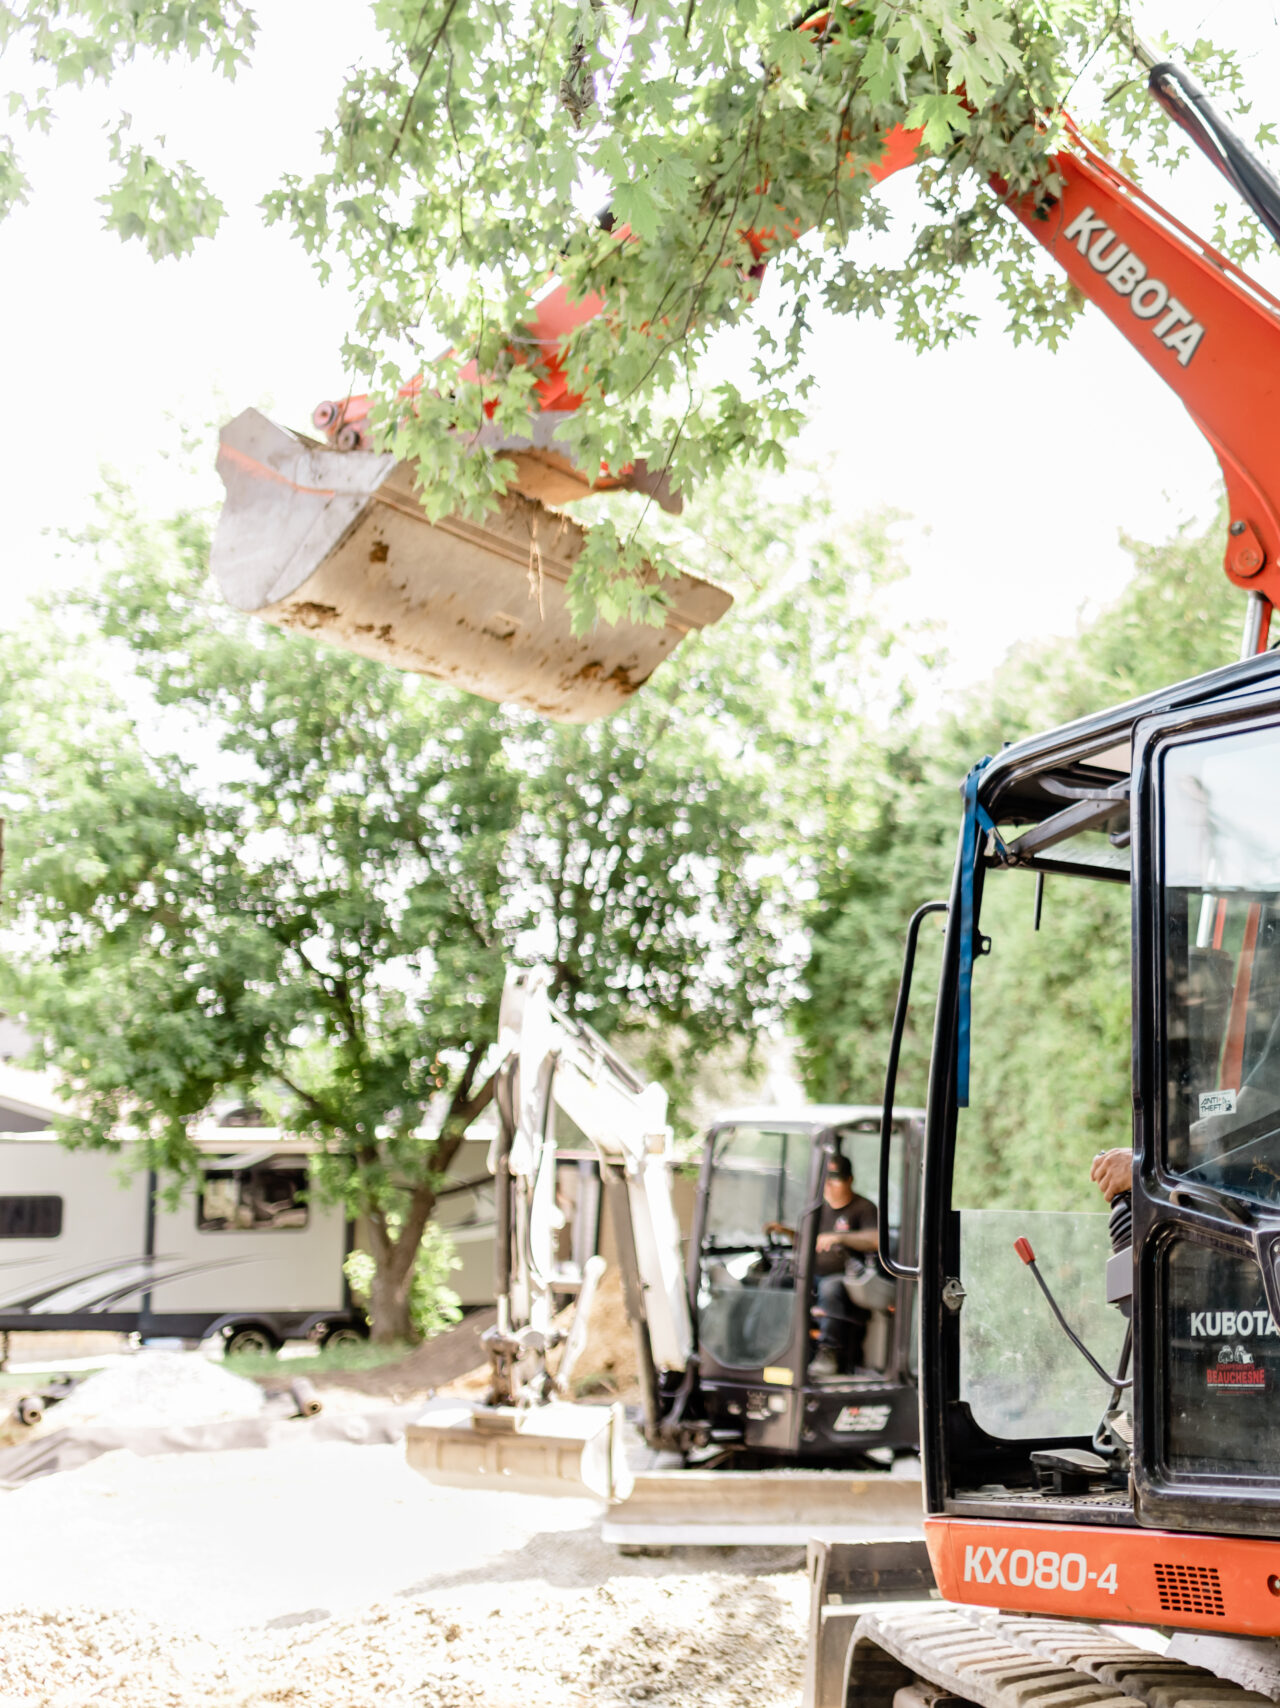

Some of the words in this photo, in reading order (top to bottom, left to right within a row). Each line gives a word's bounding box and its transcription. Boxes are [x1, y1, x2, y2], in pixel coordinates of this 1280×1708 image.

[1063, 206, 1206, 369] KUBOTA
[1206, 1368, 1266, 1385] BEAUCHESNE
[963, 1545, 1119, 1595] KX080-4
